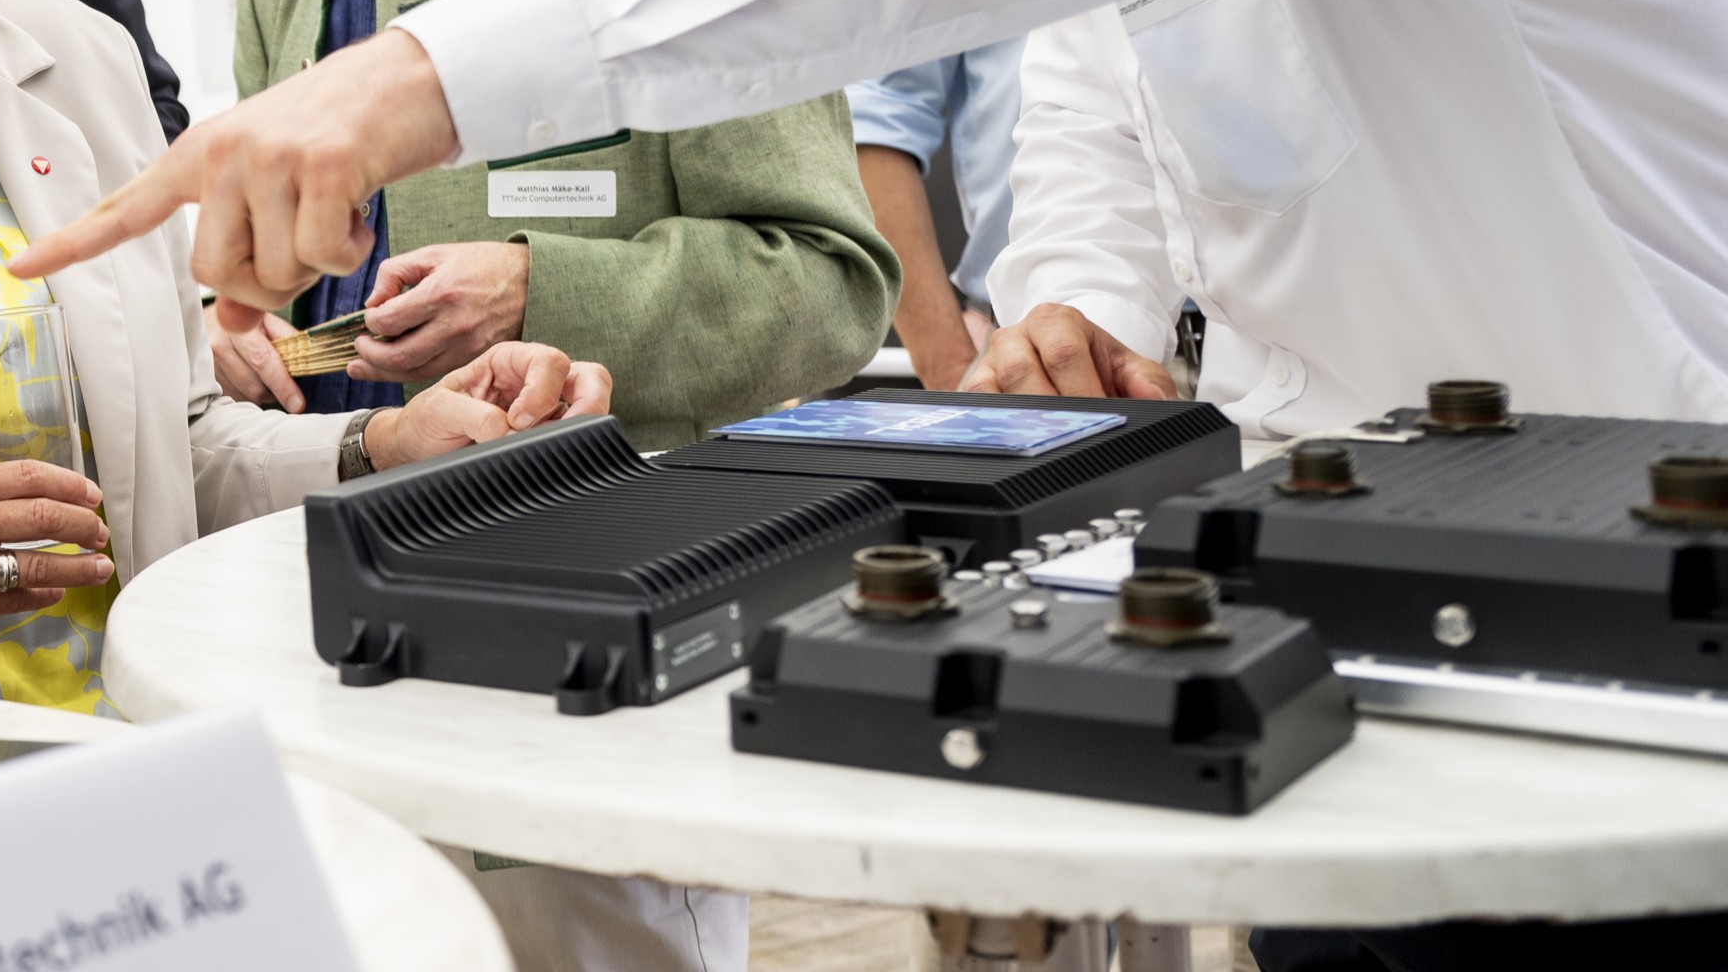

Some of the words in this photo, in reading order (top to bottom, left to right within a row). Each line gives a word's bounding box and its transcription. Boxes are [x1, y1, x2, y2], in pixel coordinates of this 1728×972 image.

[501, 195, 528, 203] TTTech
[596, 194, 607, 203] AG
[178, 860, 246, 927] AG
